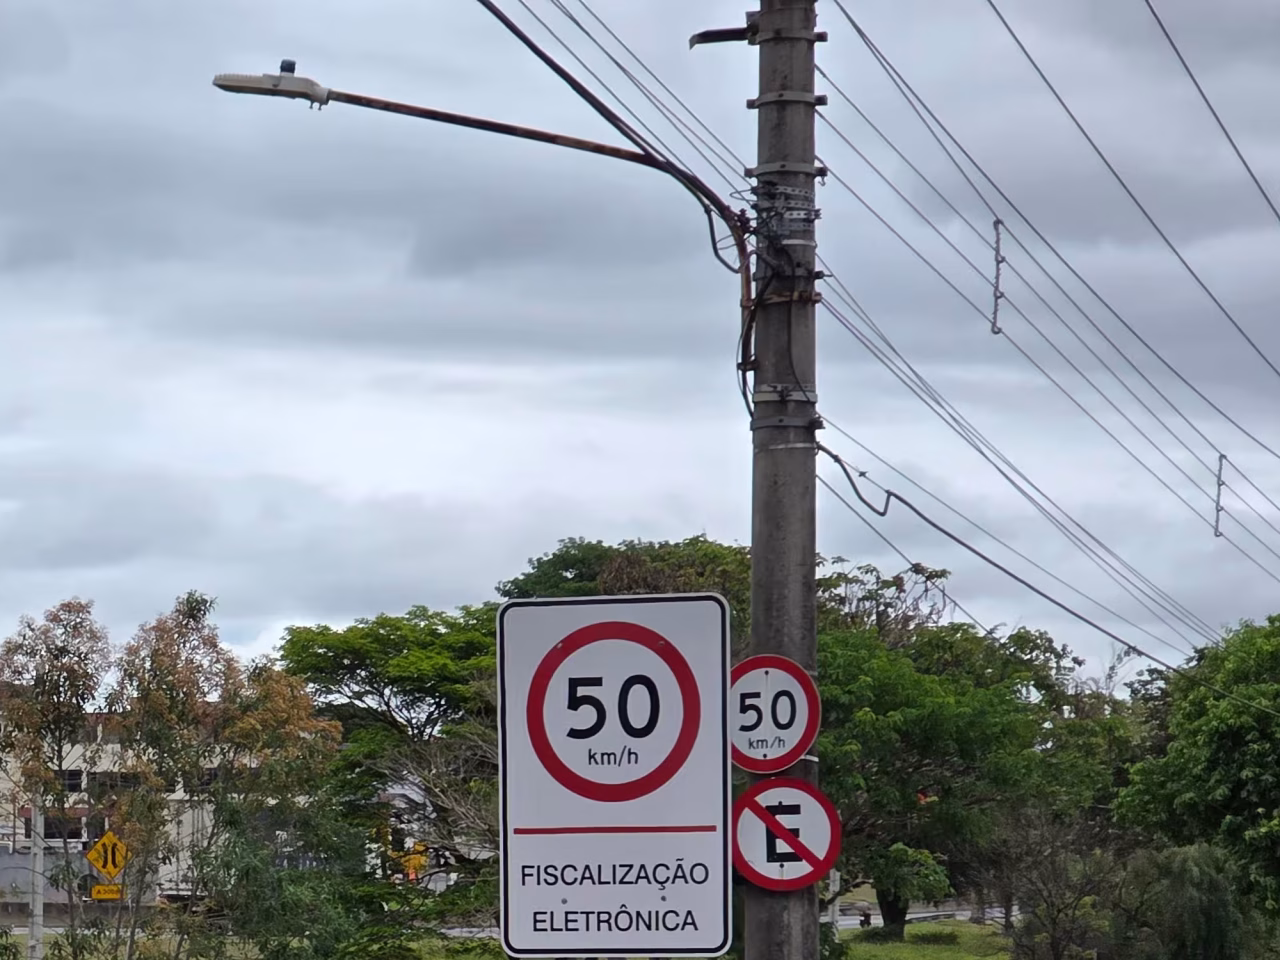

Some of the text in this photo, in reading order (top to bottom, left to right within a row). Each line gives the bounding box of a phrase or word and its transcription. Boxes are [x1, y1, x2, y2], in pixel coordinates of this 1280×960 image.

[567, 674, 661, 740] 50
[738, 689, 797, 732] 50
[587, 745, 639, 767] km/h
[747, 736, 787, 751] km/h
[764, 804, 804, 864] E
[520, 858, 710, 891] FISCALIZAÇÃO
[532, 903, 699, 933] ELETRÔNICA
